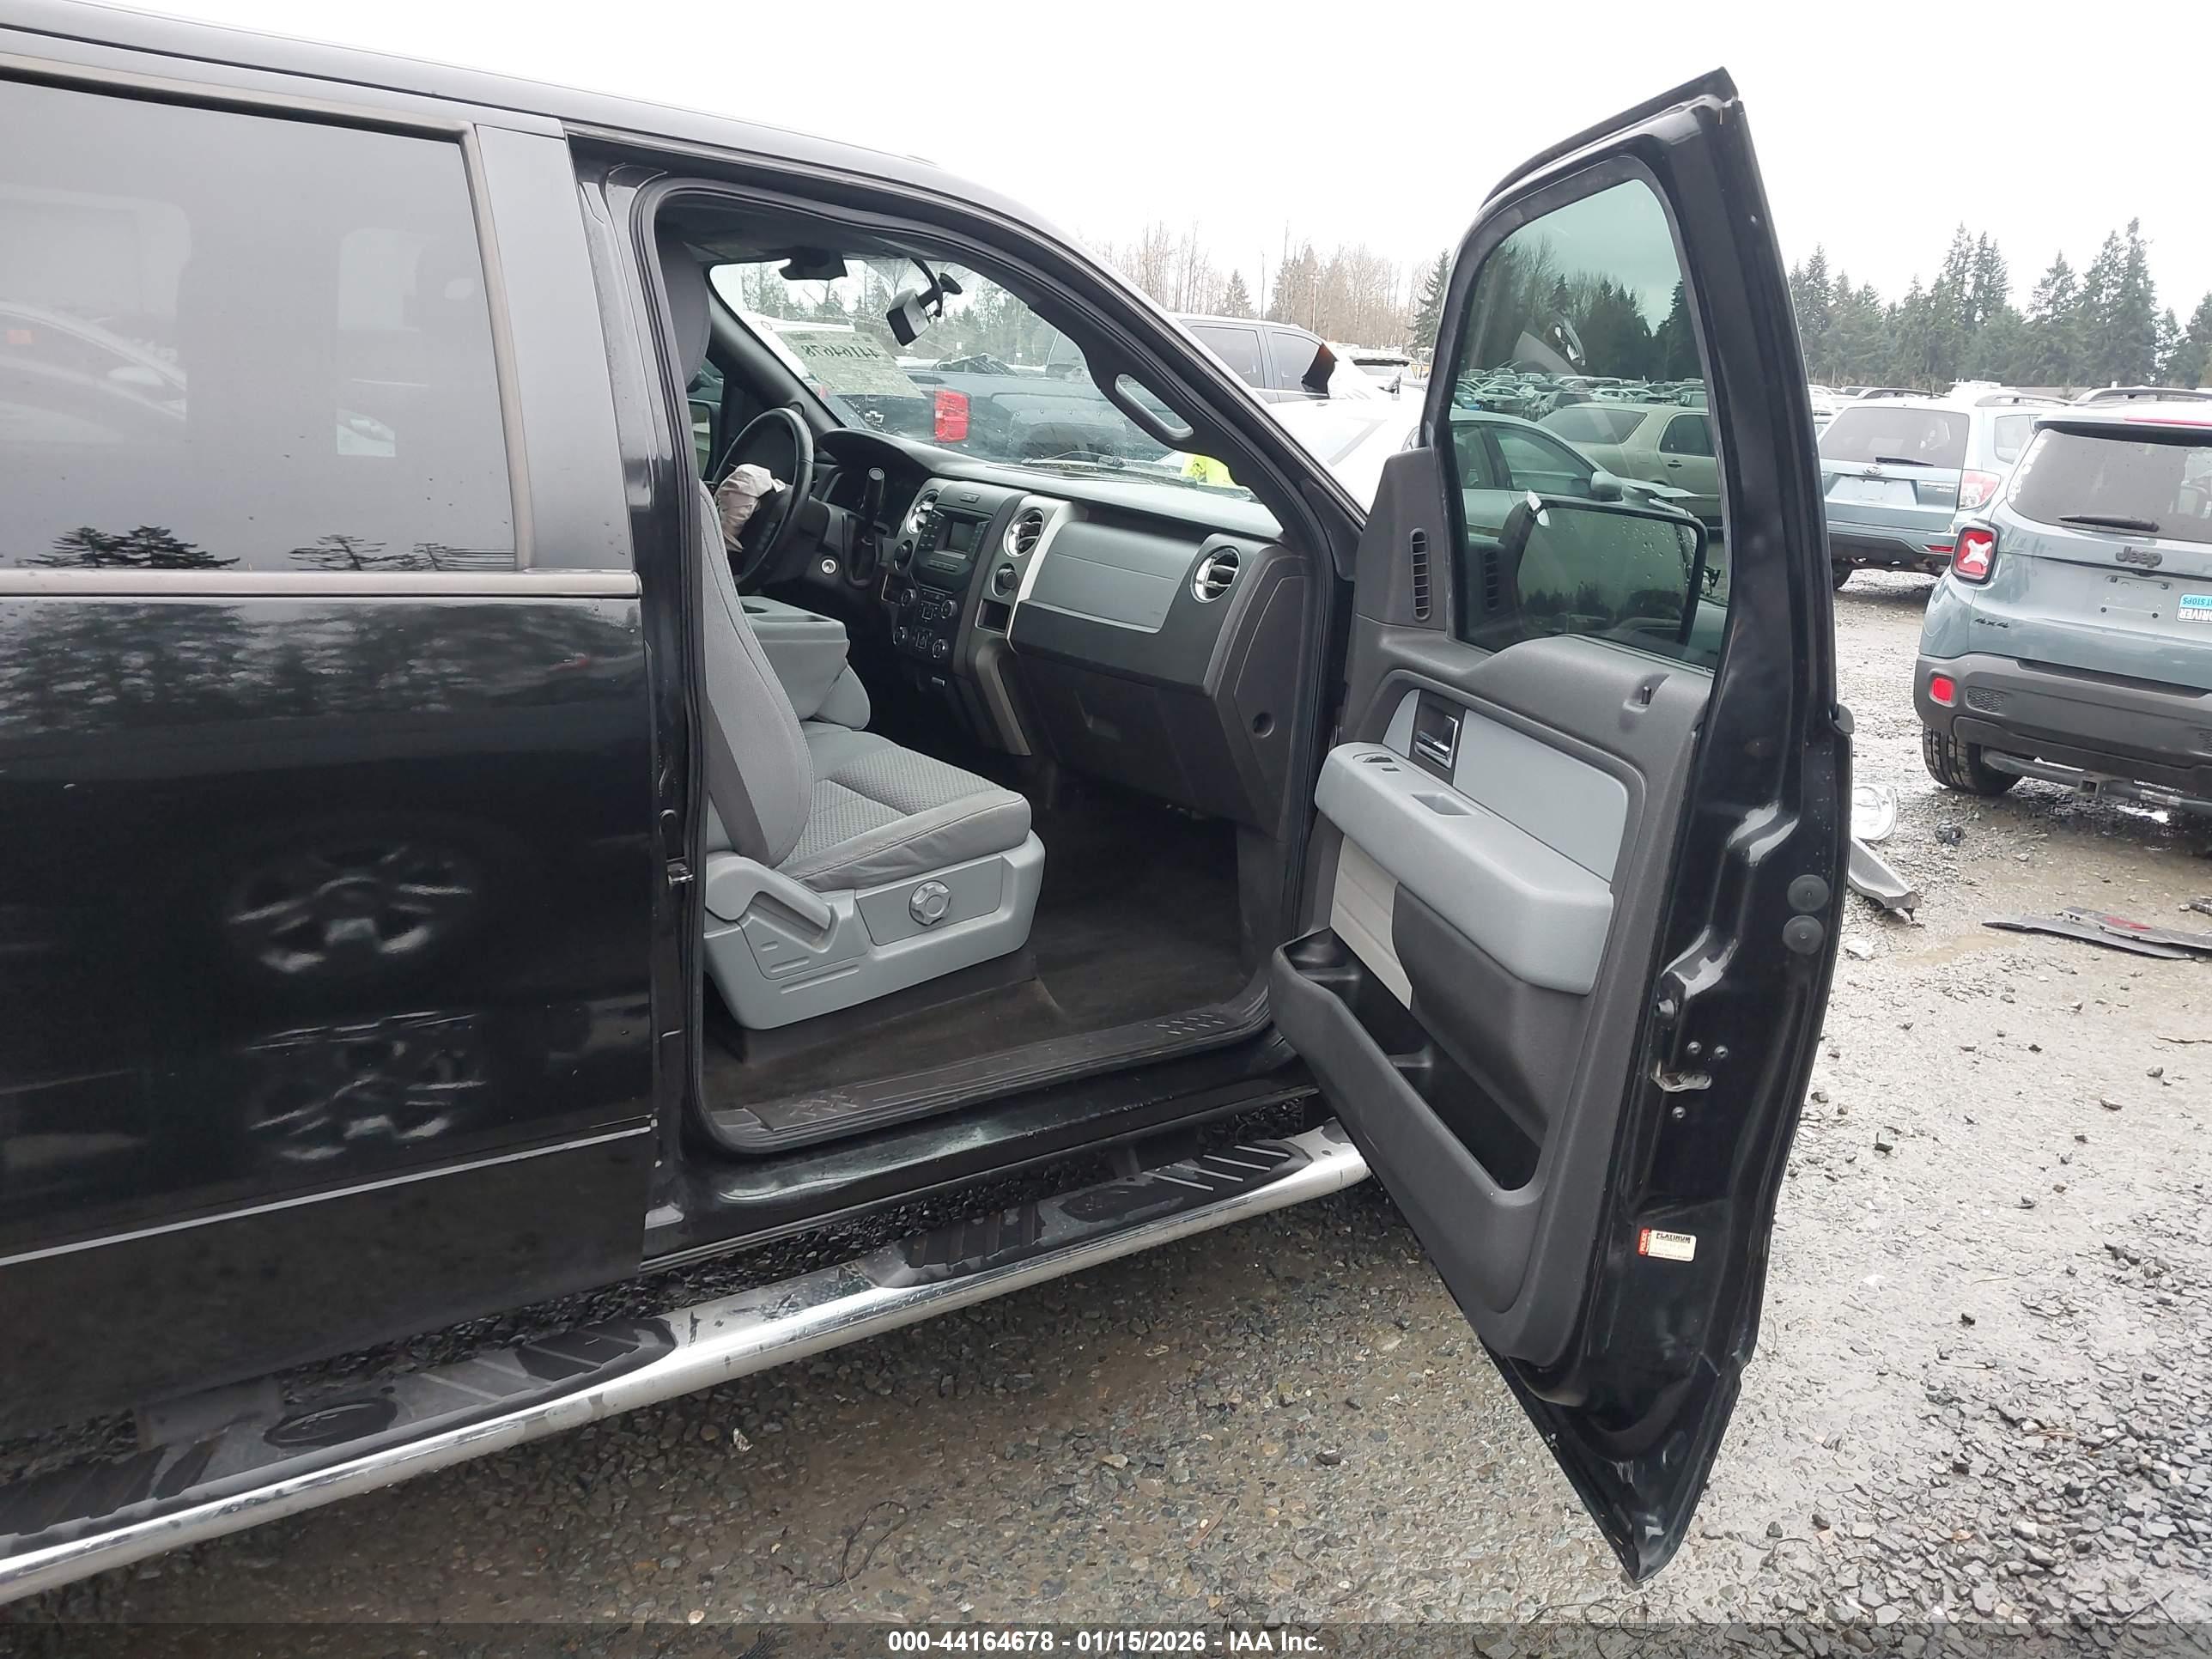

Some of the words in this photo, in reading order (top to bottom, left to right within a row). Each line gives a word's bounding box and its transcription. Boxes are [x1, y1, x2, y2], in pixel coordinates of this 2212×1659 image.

[2115, 546, 2163, 568] Jeep
[2183, 597, 2206, 606] STOPS
[1656, 1232, 1692, 1243] PLATINUM
